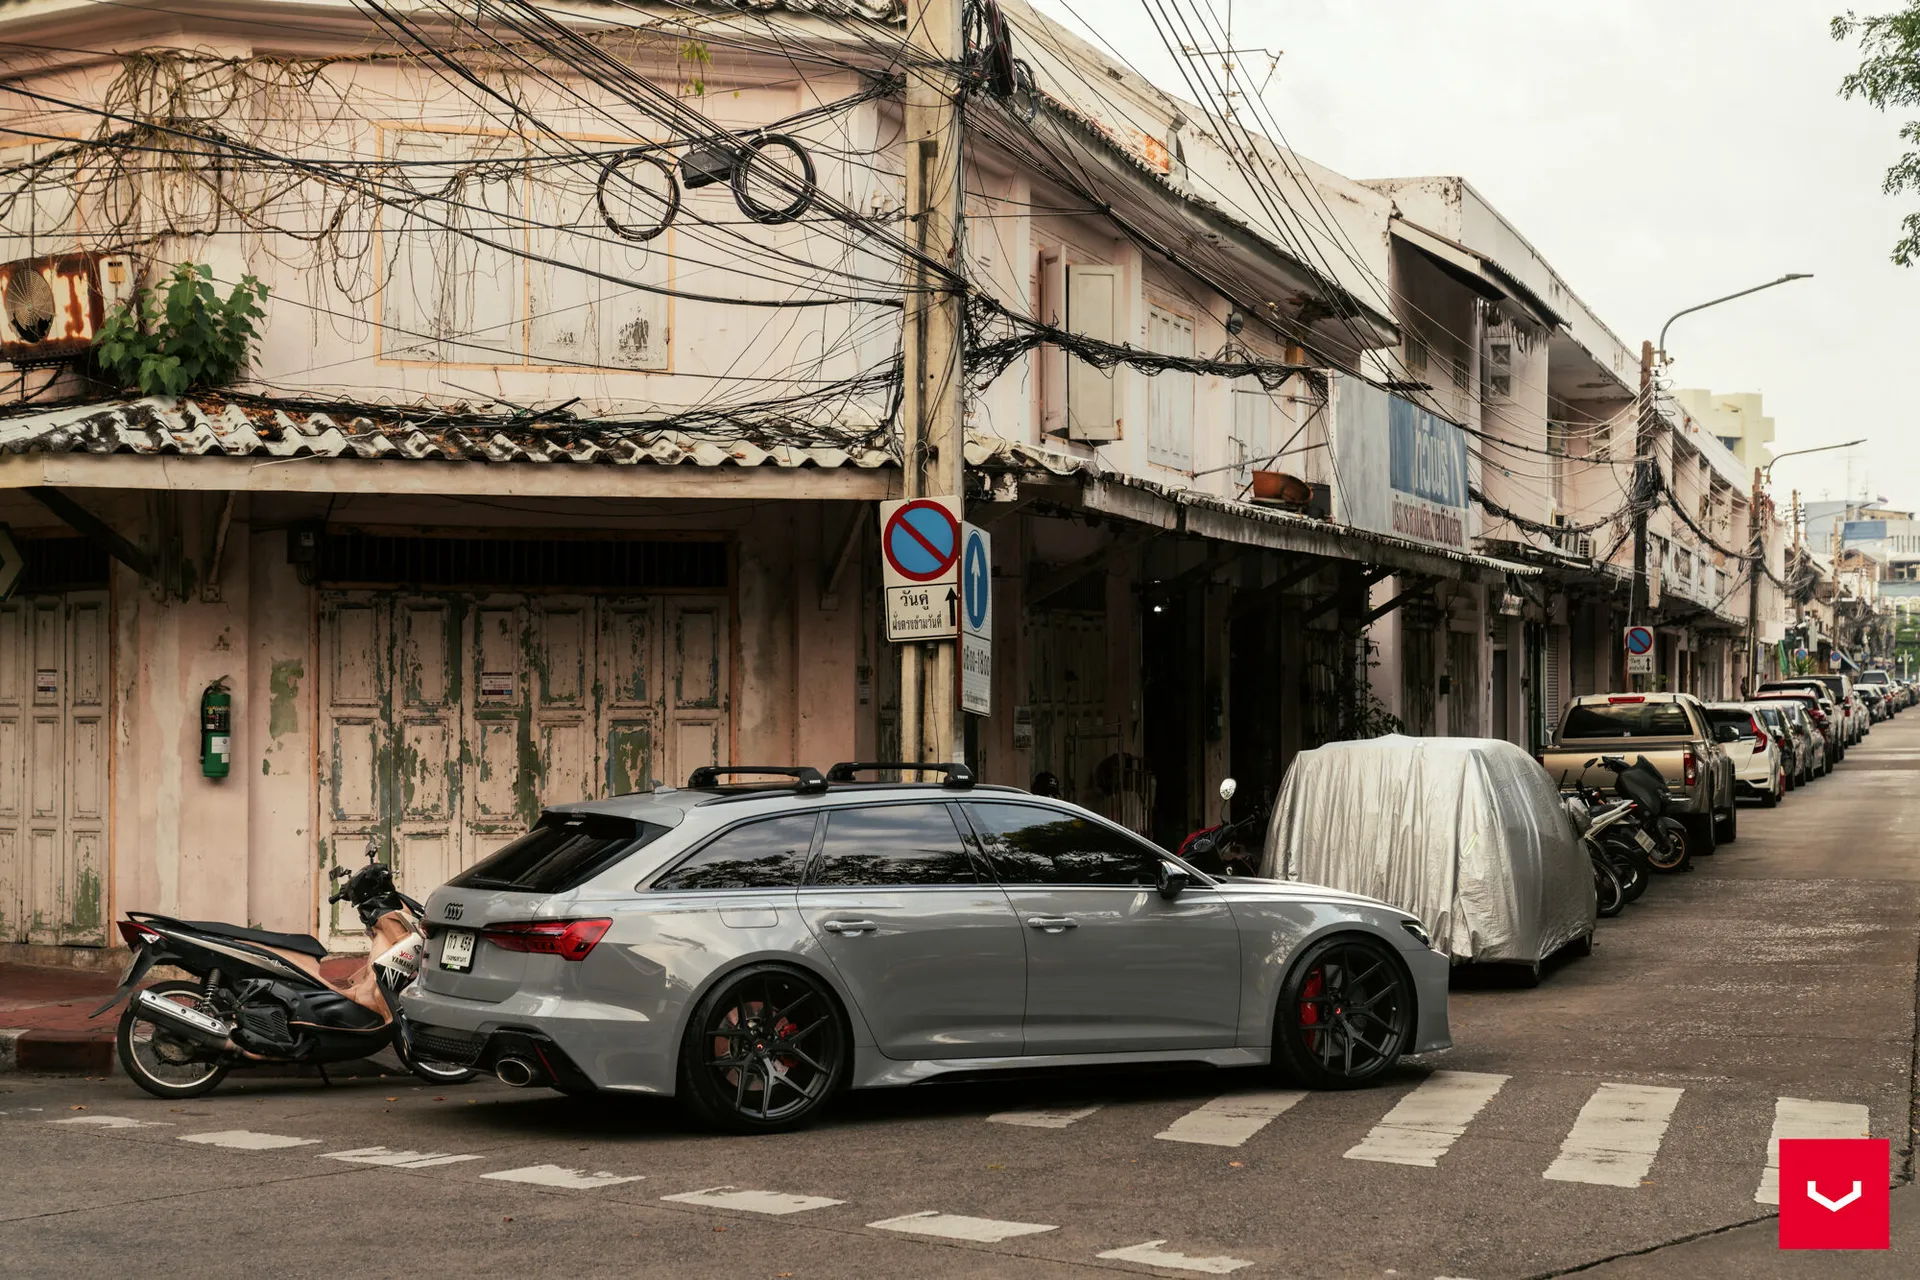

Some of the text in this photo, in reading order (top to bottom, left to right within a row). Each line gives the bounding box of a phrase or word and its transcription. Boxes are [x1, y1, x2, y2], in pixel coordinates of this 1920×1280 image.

[900, 590, 929, 610] วันคู่
[391, 956, 414, 970] YAMAHA
